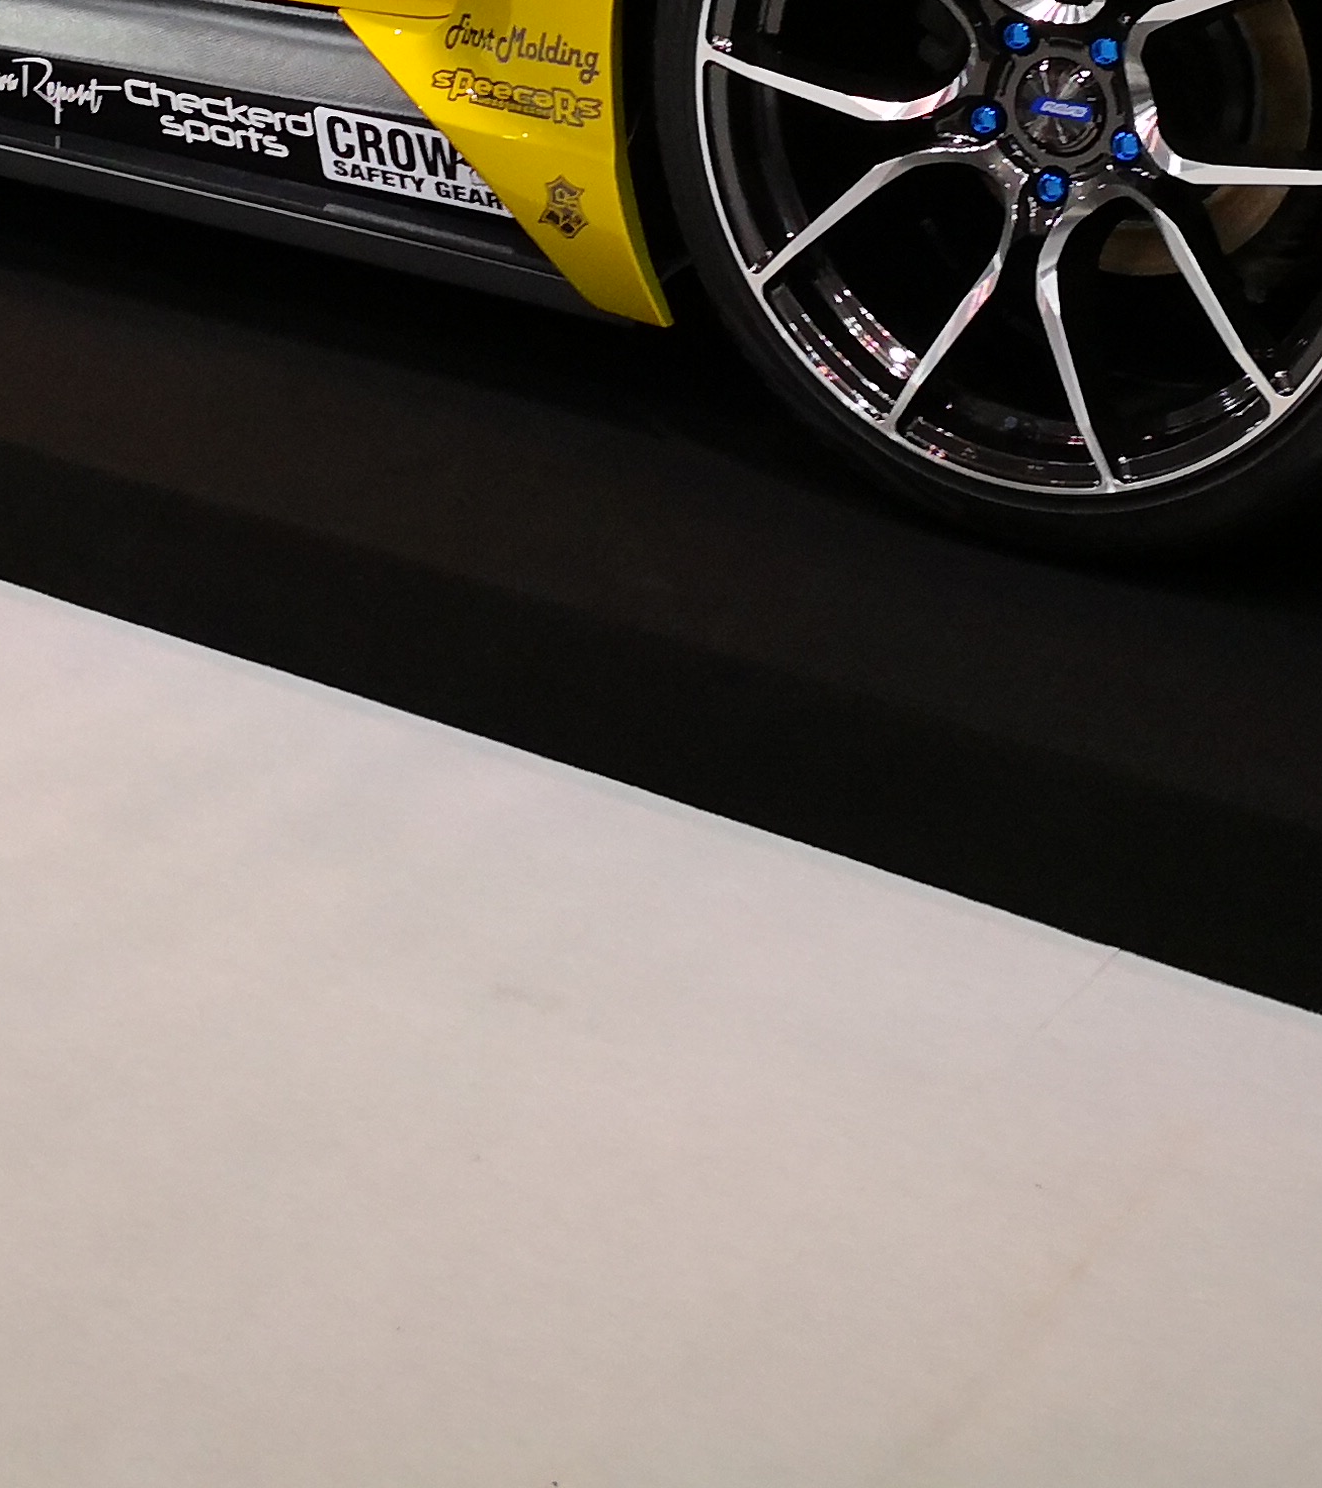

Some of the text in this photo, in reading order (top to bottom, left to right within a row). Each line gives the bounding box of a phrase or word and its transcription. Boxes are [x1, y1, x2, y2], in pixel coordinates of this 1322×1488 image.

[496, 25, 600, 84] Molding
[123, 78, 314, 137] Checkerd
[334, 160, 425, 193] SAFETY
[435, 181, 505, 210] GEAR
